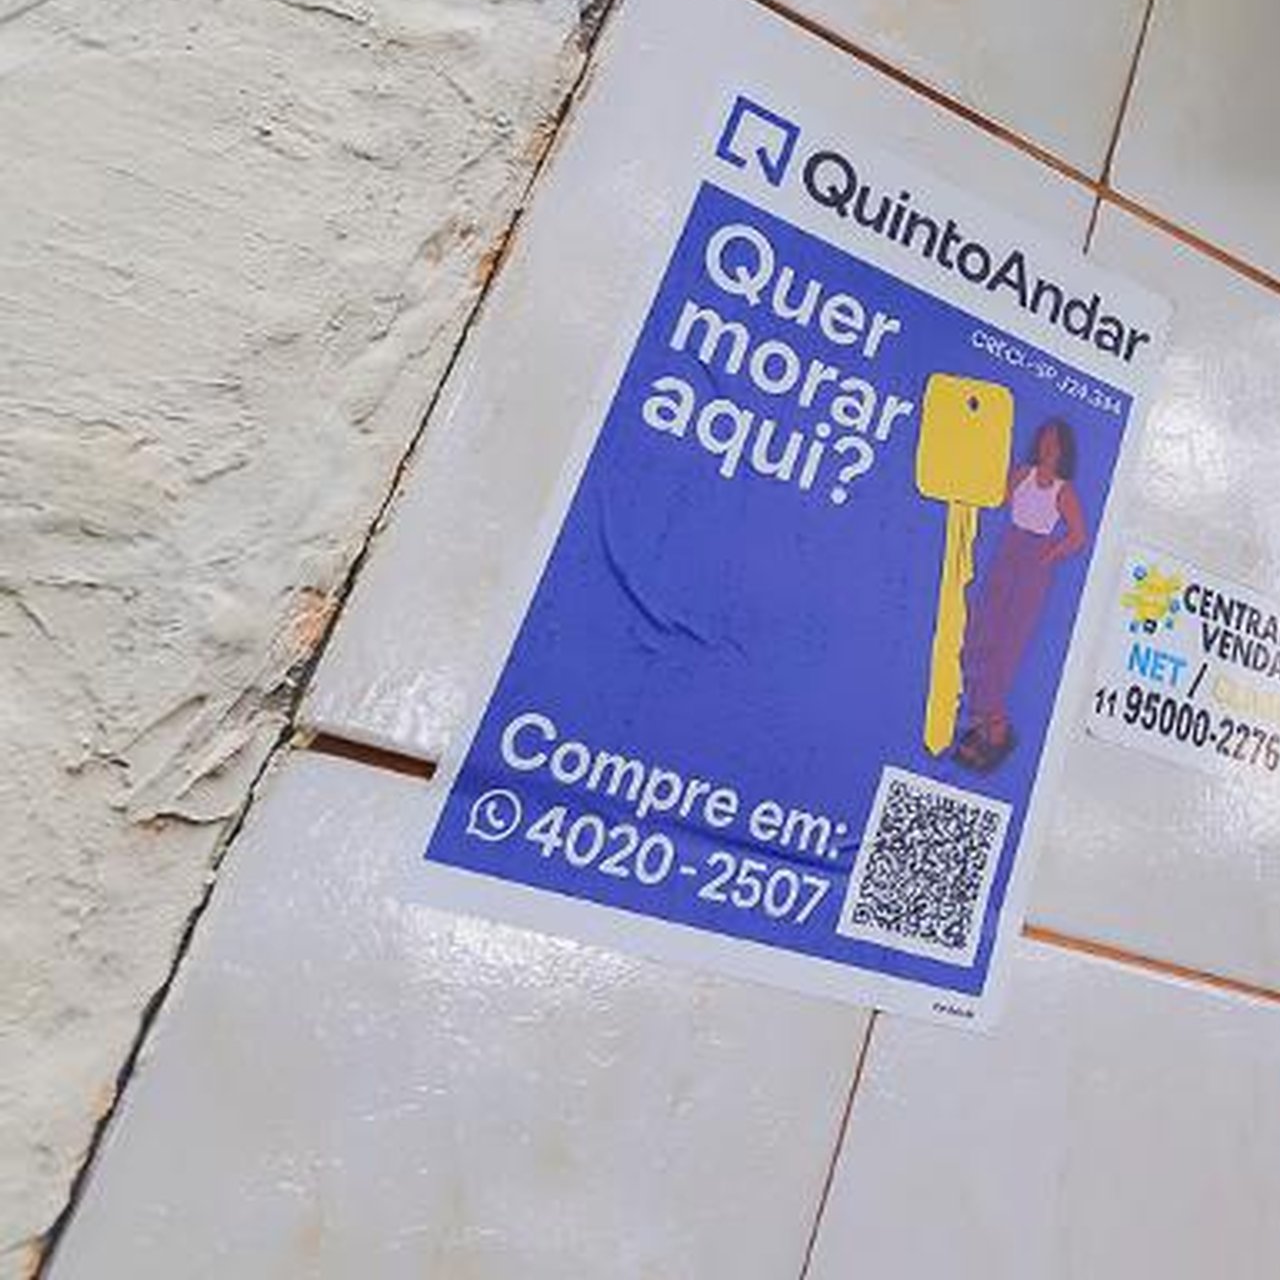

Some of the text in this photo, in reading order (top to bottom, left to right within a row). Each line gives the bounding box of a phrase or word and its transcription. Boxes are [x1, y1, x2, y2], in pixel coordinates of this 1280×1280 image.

[705, 224, 901, 359] Quer
[802, 150, 1149, 363] QuintoAndar
[669, 298, 914, 442] morar
[642, 374, 875, 504] aqui?
[1127, 643, 1188, 687] NET
[501, 713, 848, 860] Compre em:
[526, 805, 831, 924] 4020-2507
